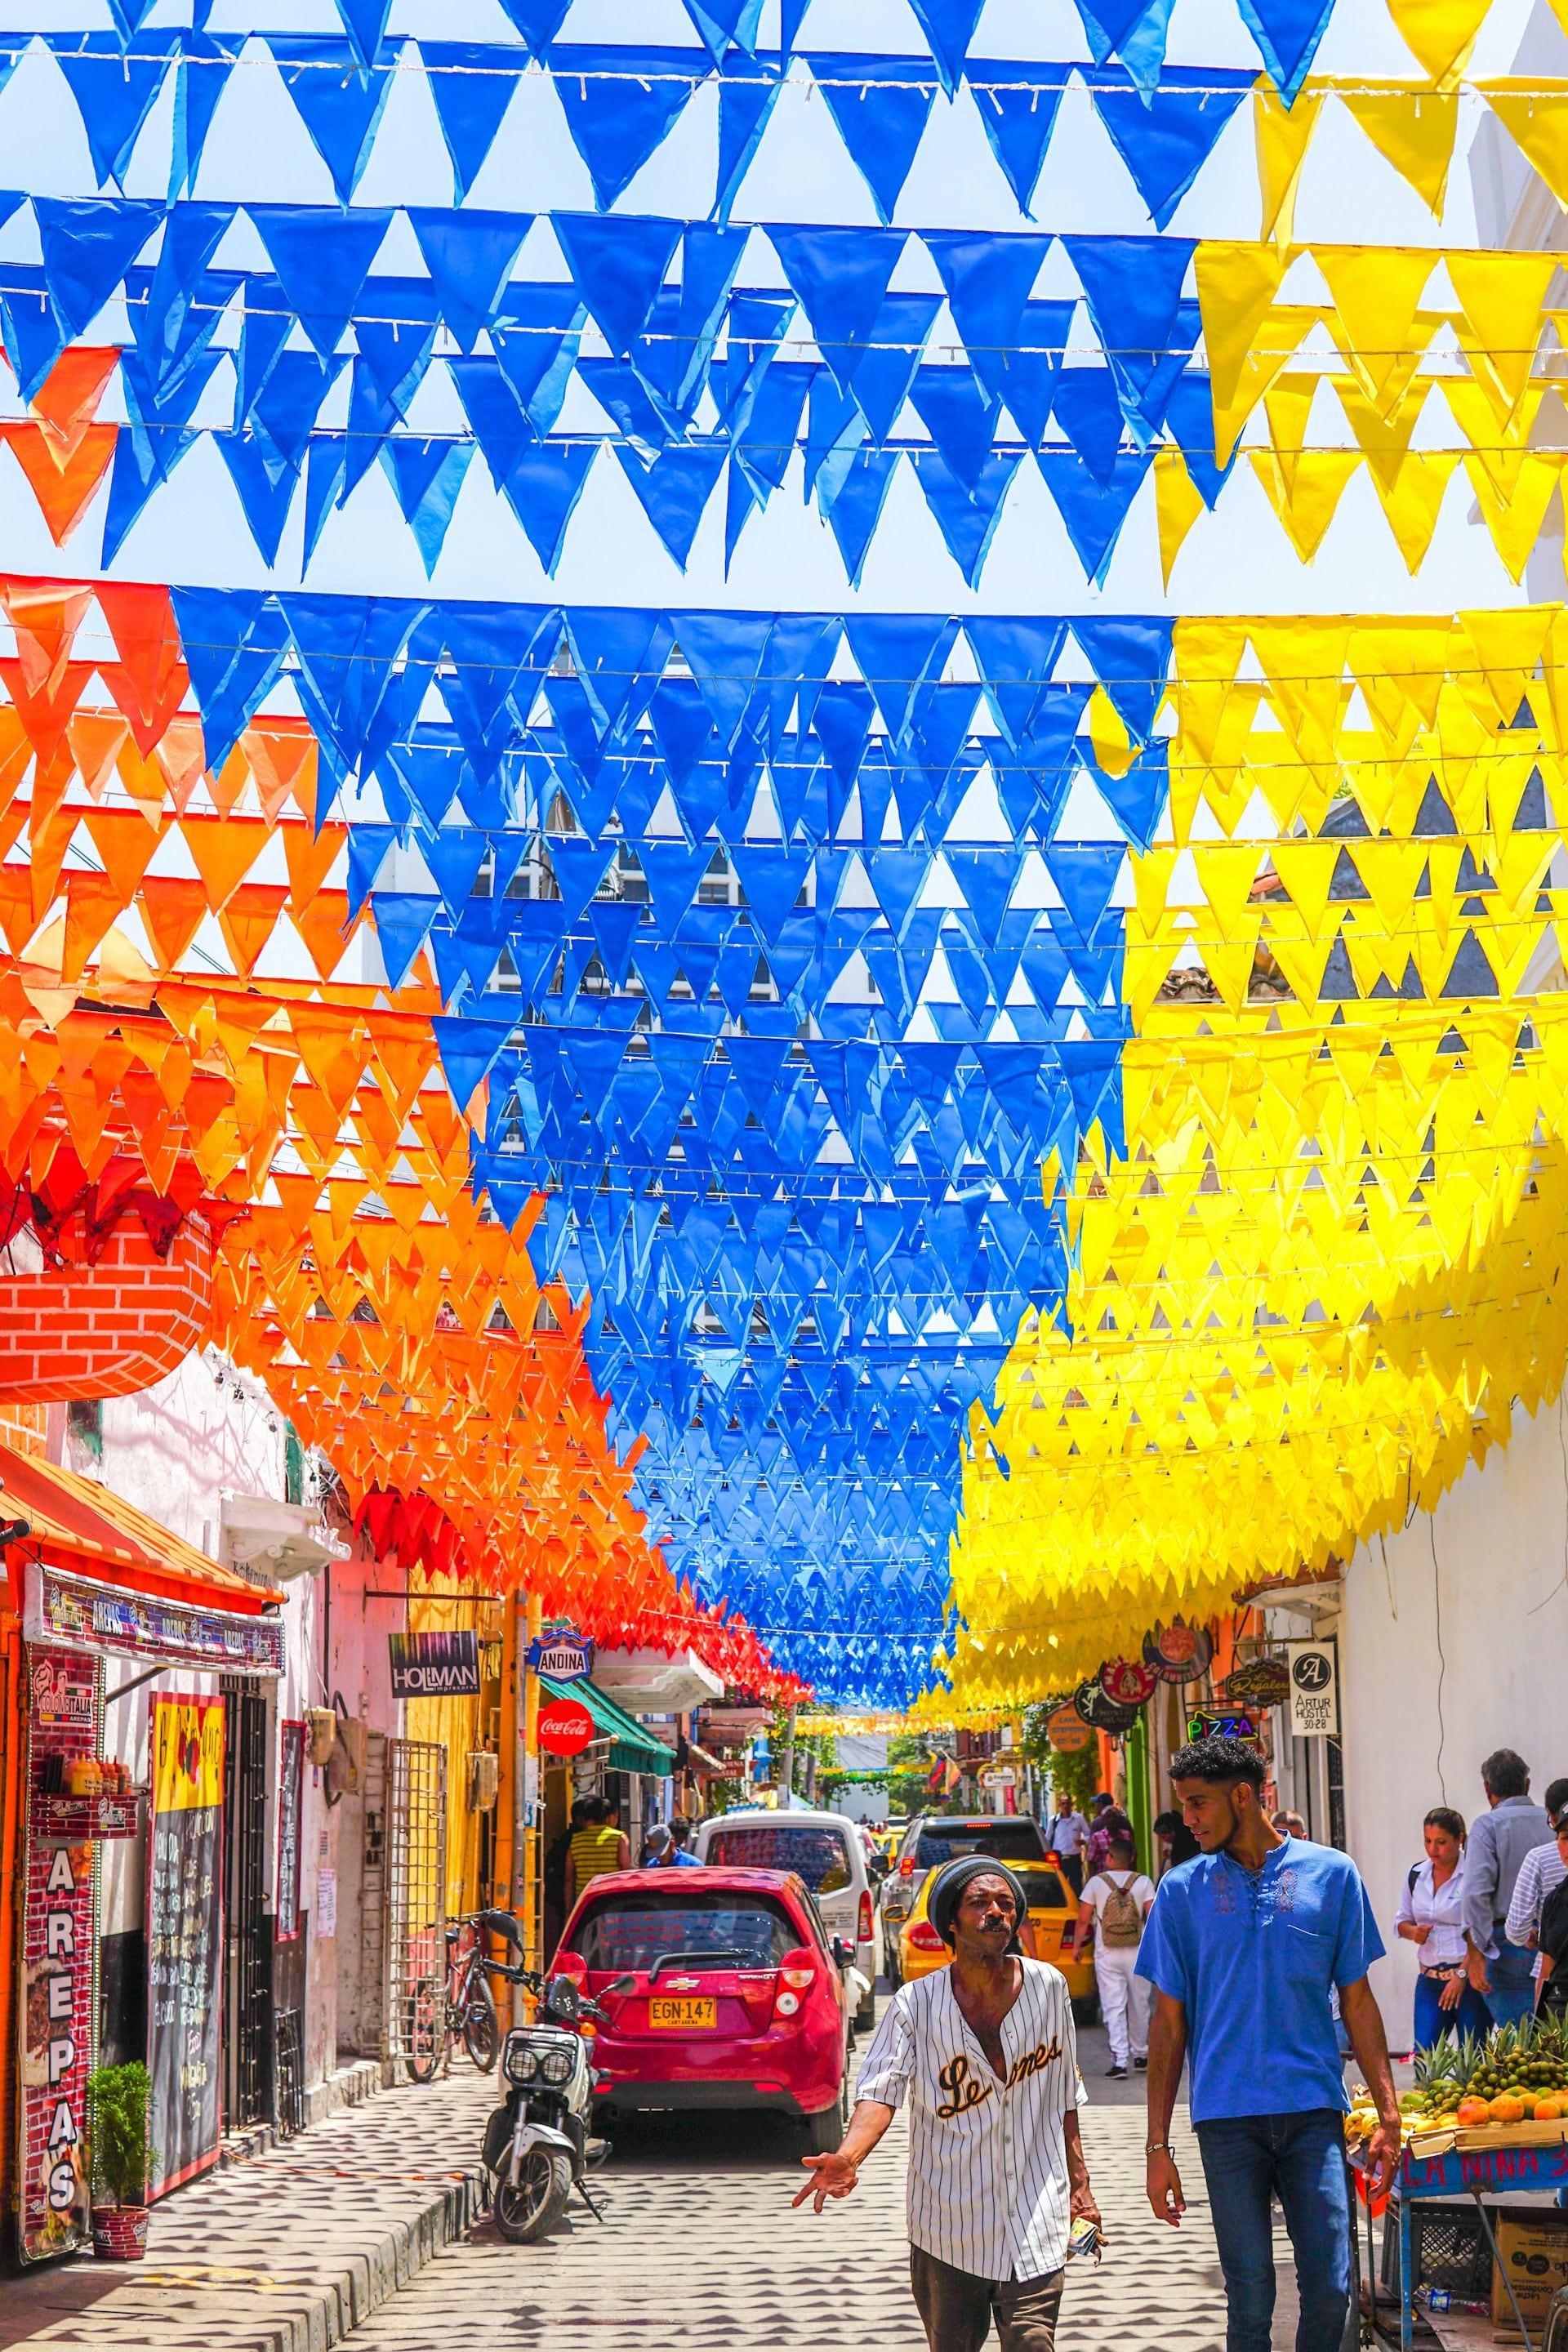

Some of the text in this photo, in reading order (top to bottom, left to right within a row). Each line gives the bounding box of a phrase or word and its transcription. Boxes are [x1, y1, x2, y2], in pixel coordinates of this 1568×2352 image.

[92, 1599, 123, 1636] AREPAS
[540, 1653, 585, 1670] ANDINA
[393, 1665, 478, 1691] HOLLMAN
[40, 1694, 91, 1714] COLOMBITALIA
[1295, 1695, 1331, 1708] ARTUR
[69, 1715, 91, 1723] AREPAS
[1296, 1708, 1331, 1718] HOSTEL
[540, 1717, 589, 1736] Coca-Cola
[1190, 1719, 1253, 1739] PIZZA
[1303, 1719, 1326, 1729] 30-28
[46, 1847, 78, 2211] AREPAS
[1402, 2149, 1446, 2186] LA
[1503, 2283, 1553, 2294] Condensaa
